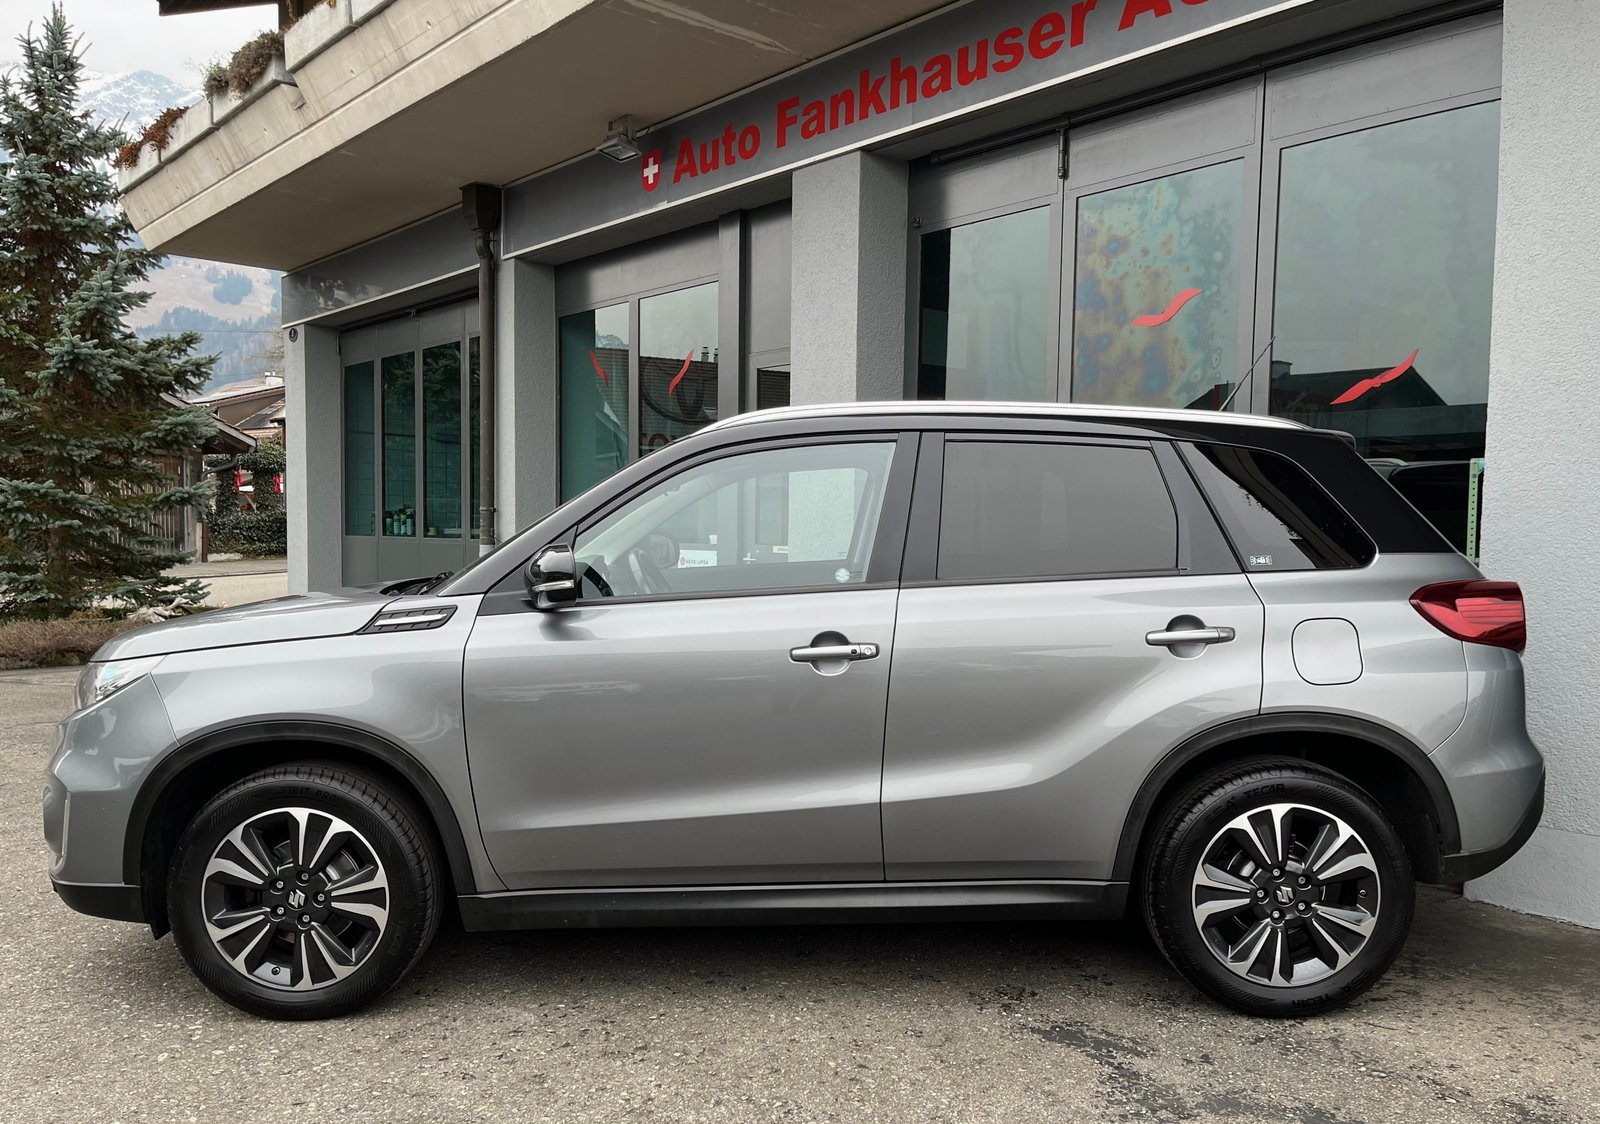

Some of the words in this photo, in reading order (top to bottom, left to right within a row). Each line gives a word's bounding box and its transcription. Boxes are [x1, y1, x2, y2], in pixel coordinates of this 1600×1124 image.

[672, 124, 761, 184] Auto
[775, 0, 1098, 149] Fankhauser
[1118, 0, 1208, 31] A
